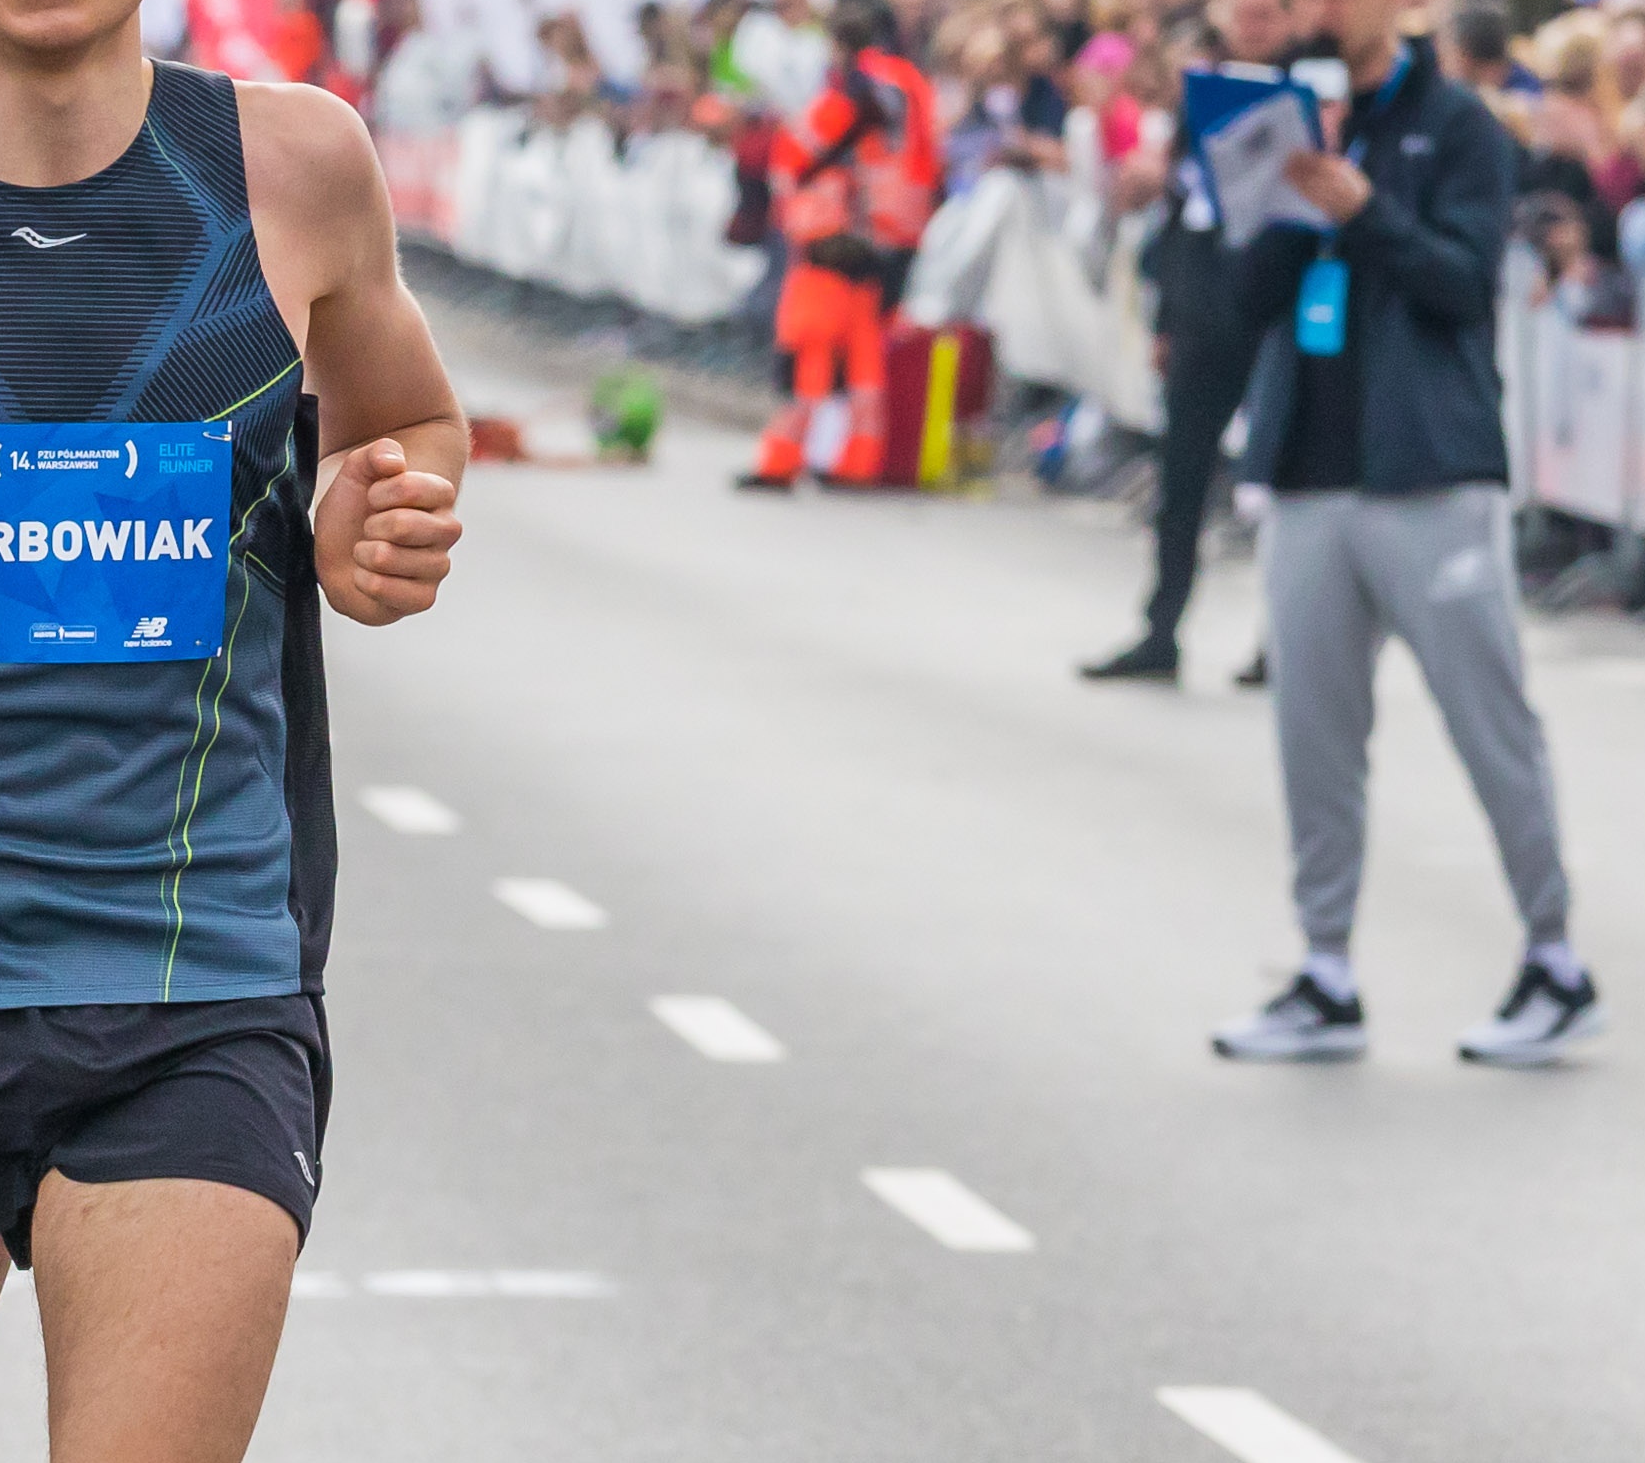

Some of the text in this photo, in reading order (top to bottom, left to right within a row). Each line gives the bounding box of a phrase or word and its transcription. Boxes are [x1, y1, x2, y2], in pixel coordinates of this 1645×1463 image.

[37, 450, 56, 459] PZU
[57, 448, 120, 459] PÓŁMARATON
[159, 443, 195, 458] ELITE
[37, 460, 99, 470] WARSZAWSKI
[159, 459, 213, 474] RUNNER
